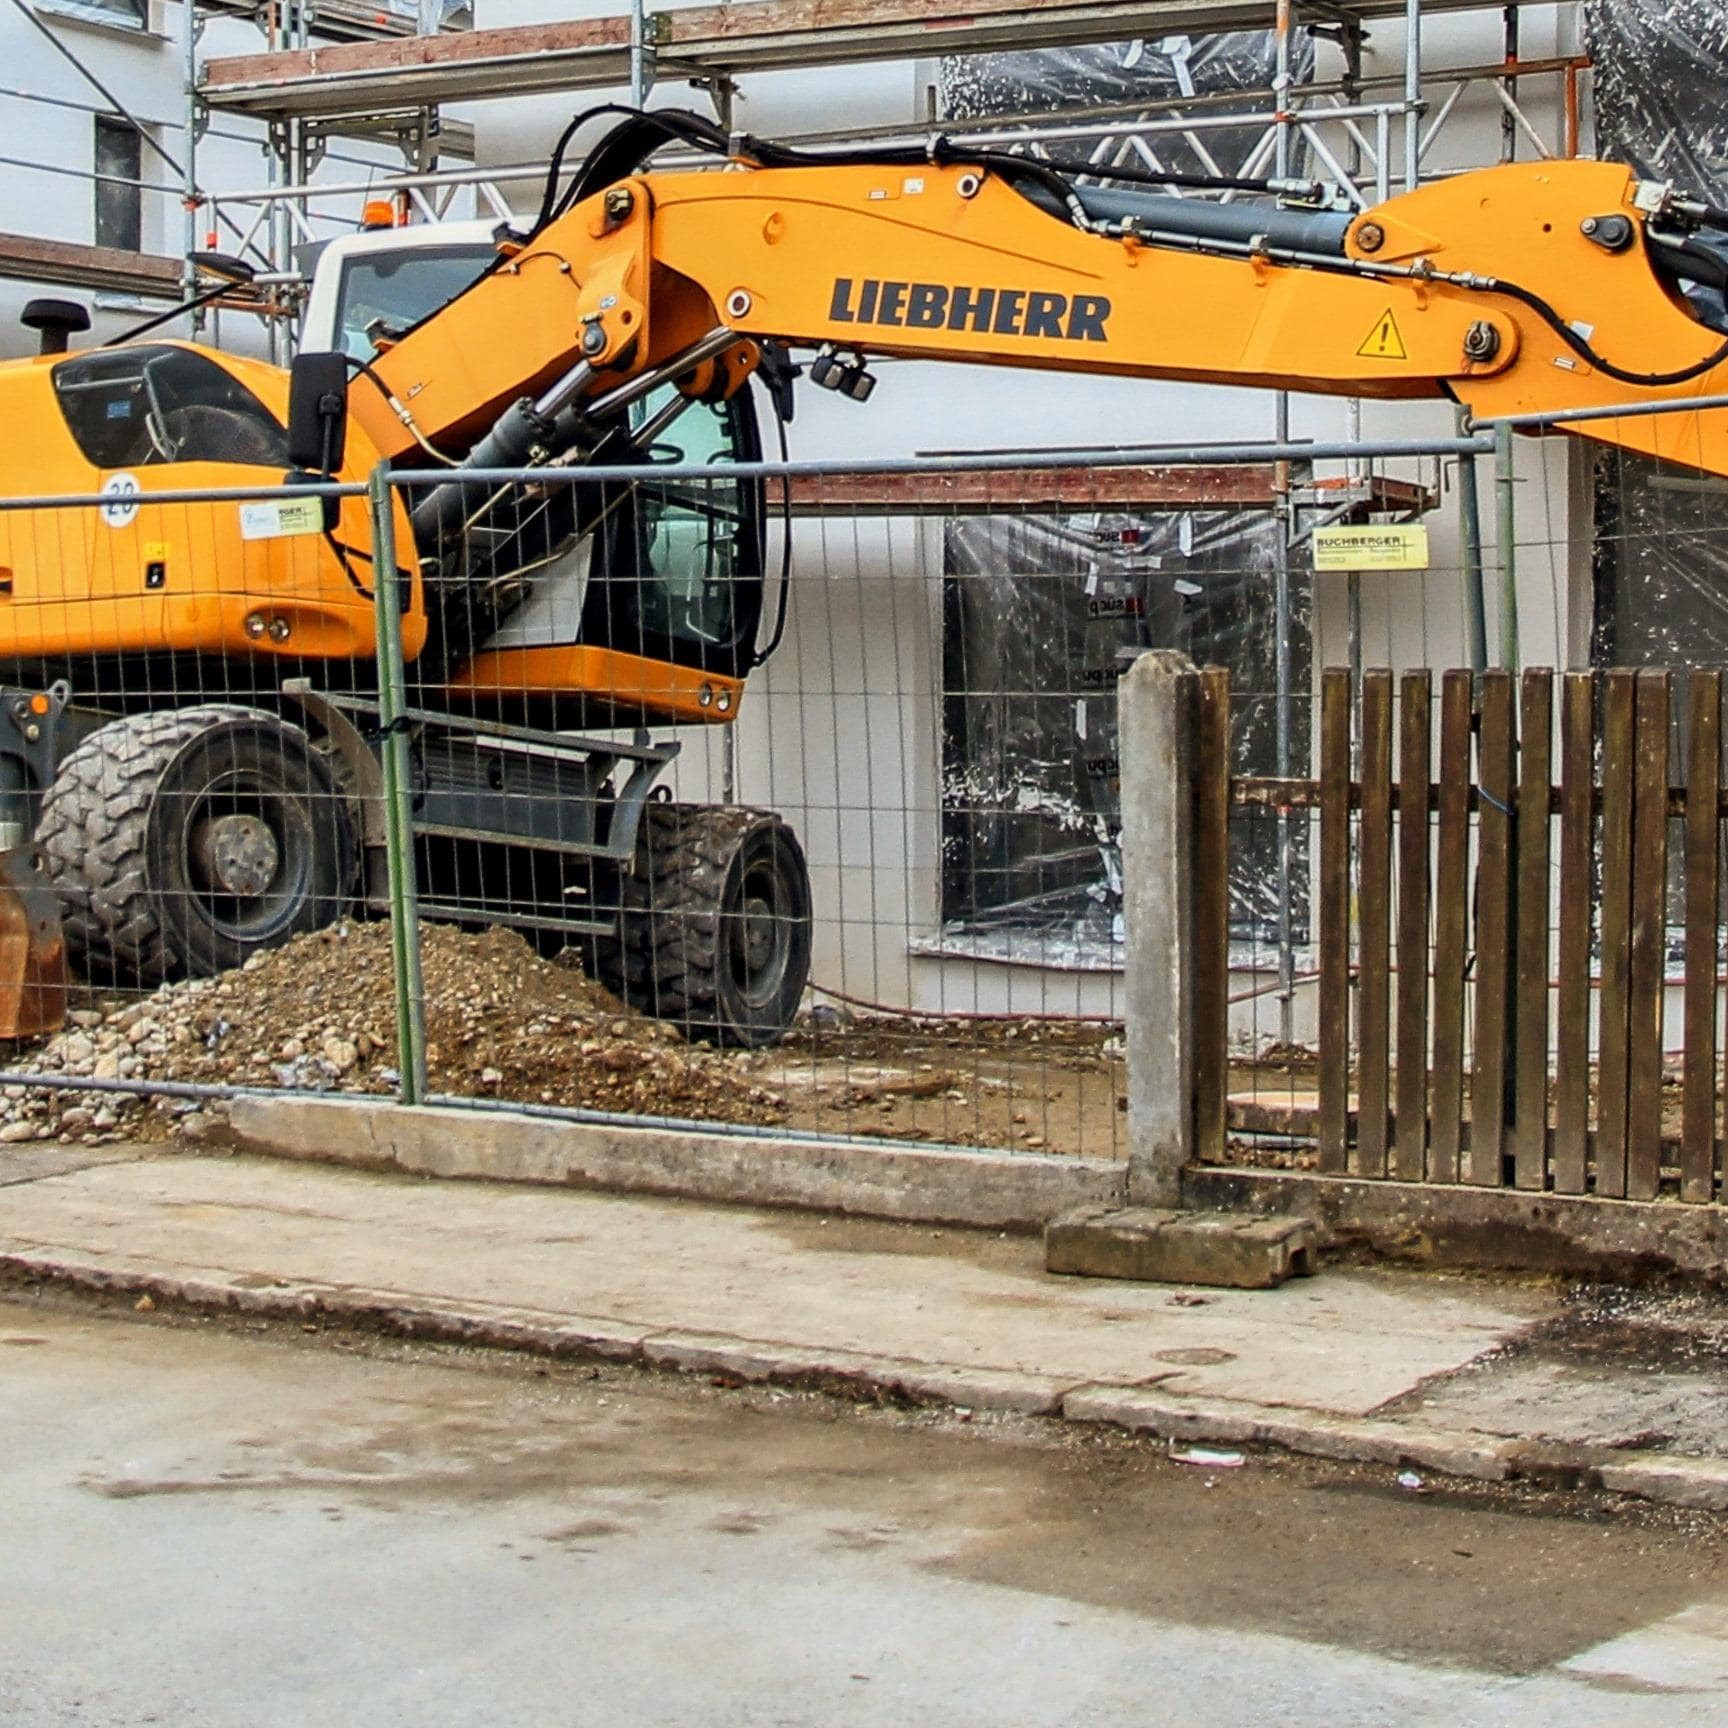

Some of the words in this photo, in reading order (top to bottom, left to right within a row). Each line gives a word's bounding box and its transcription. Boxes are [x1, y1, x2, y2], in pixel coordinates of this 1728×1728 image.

[828, 277, 1112, 343] LIEBHERR
[108, 481, 135, 517] 20
[1316, 535, 1401, 547] BUCHBERGER
